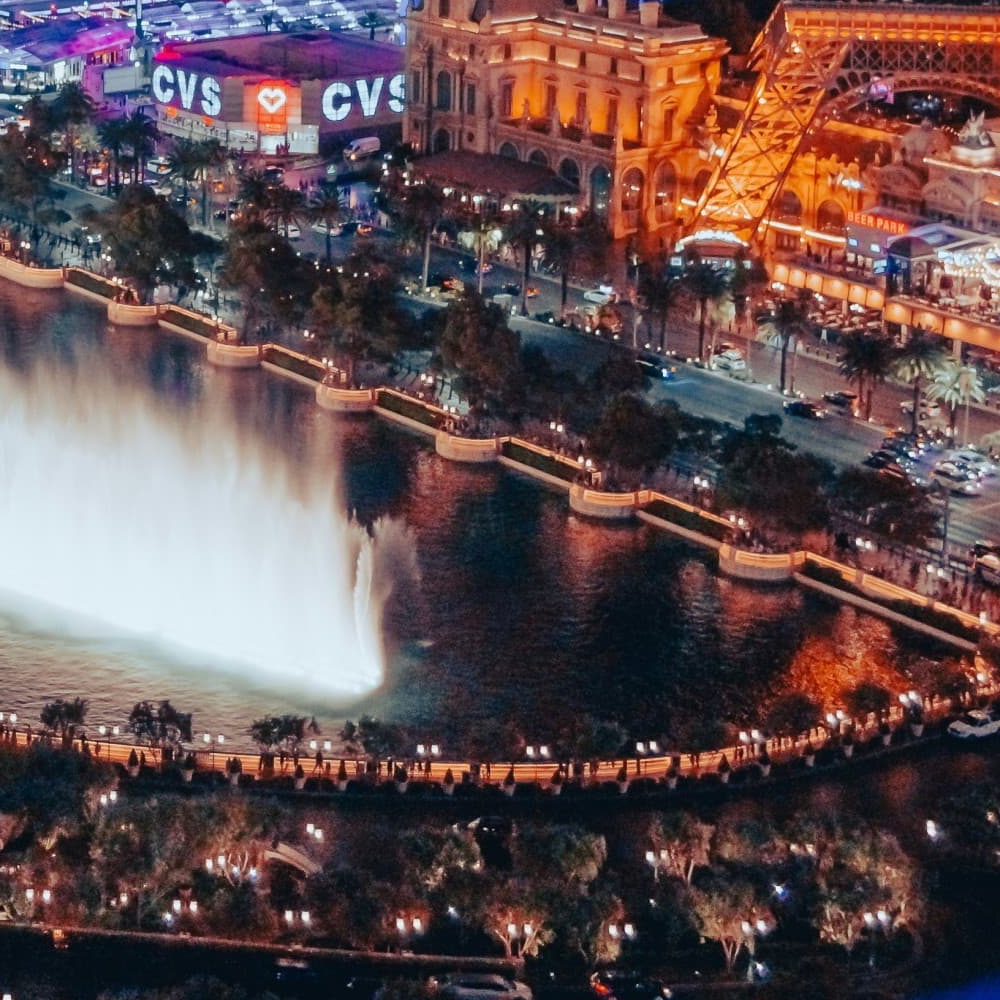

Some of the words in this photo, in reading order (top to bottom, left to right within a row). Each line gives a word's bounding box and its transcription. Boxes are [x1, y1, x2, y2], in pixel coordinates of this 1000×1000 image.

[152, 64, 222, 117] CVS
[321, 73, 406, 122] CVS
[847, 211, 874, 227] BEER
[876, 217, 905, 234] PARK
